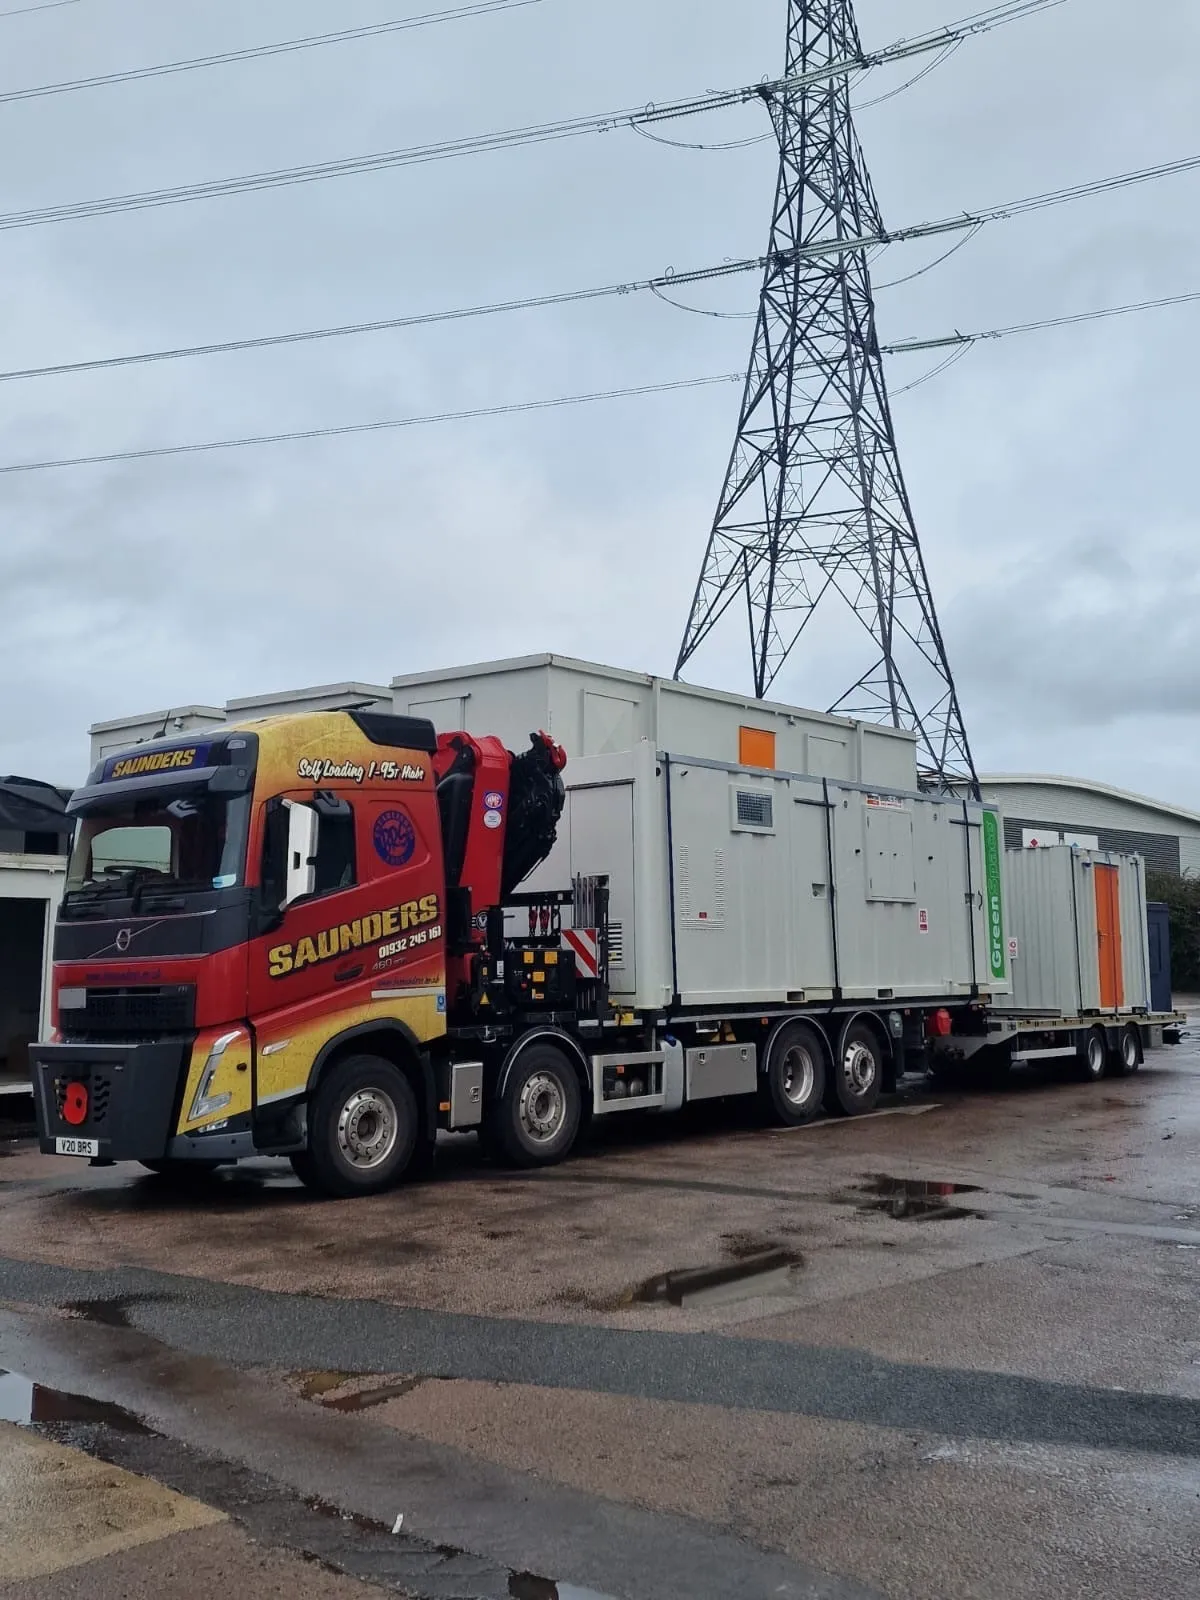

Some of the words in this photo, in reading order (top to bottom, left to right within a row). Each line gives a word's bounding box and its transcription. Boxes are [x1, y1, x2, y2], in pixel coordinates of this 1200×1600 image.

[111, 748, 197, 779] SAUNDERS
[298, 758, 323, 783] Self
[323, 759, 365, 783] Loading
[401, 764, 425, 781] Hiabs
[267, 893, 439, 978] SAUNDERS
[378, 938, 408, 959] 01932
[409, 930, 427, 948] 245
[428, 925, 442, 940] 161
[371, 958, 394, 972] 460
[61, 1139, 76, 1153] V20
[77, 1140, 93, 1154] BRS
